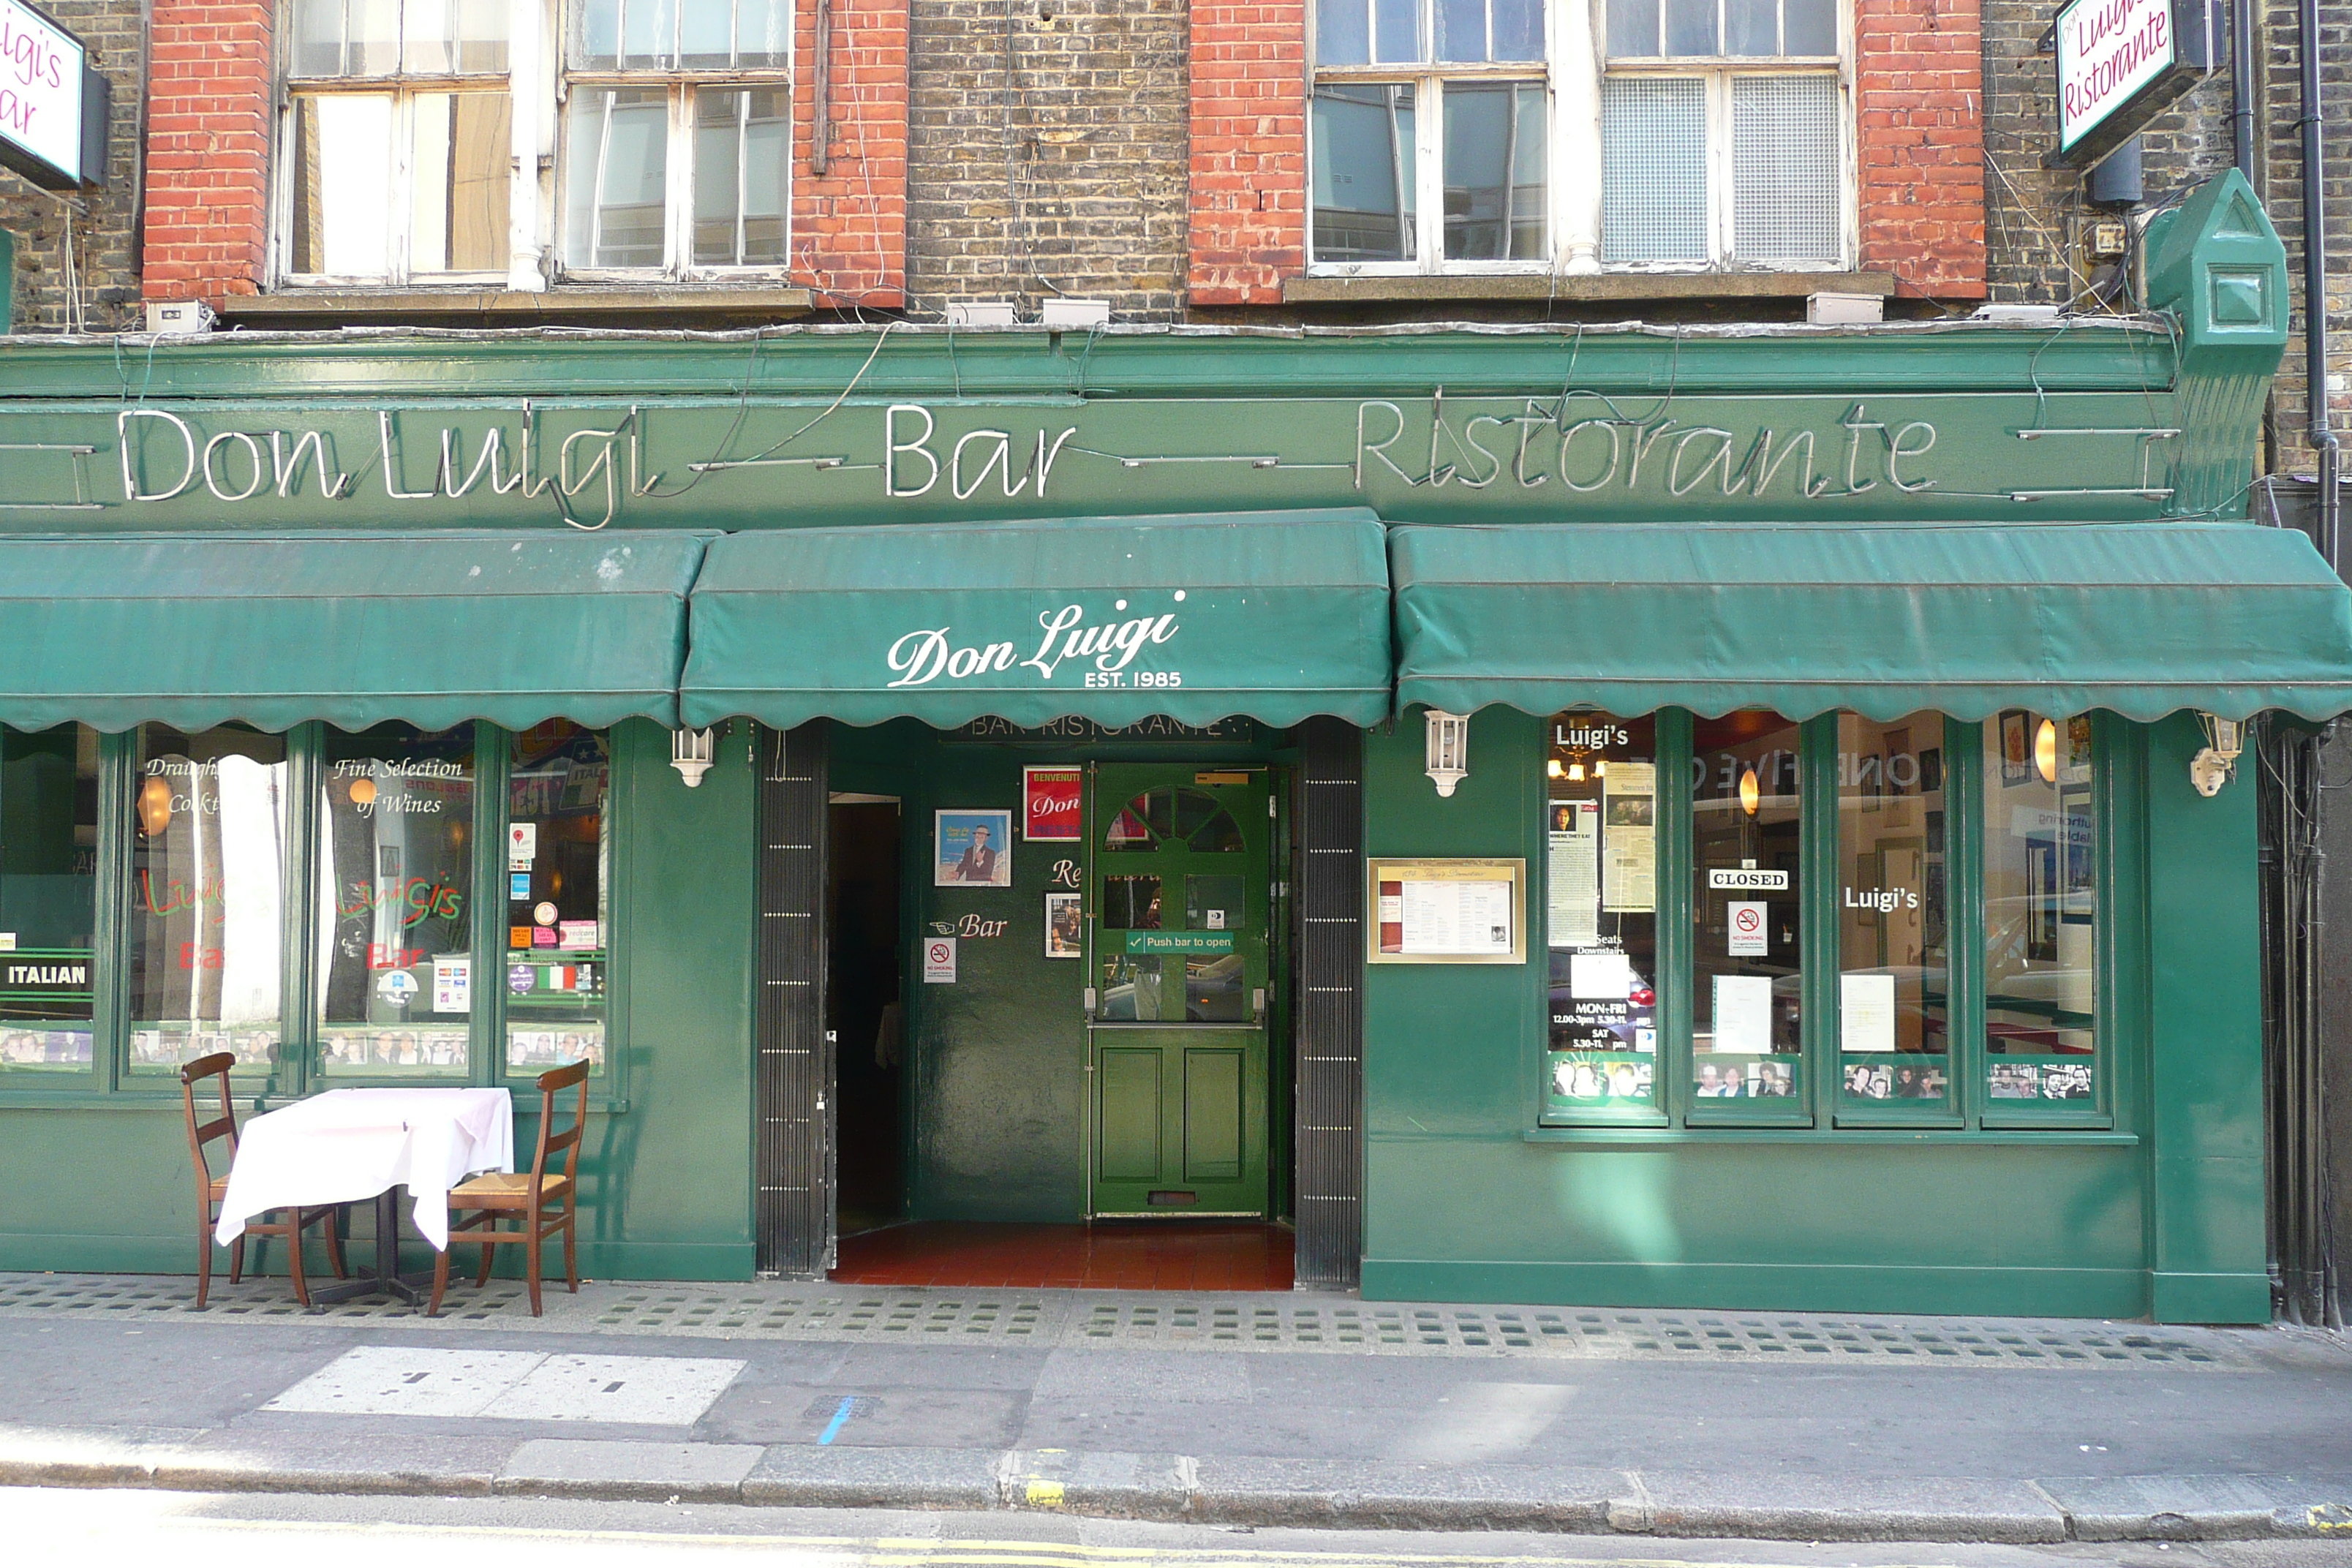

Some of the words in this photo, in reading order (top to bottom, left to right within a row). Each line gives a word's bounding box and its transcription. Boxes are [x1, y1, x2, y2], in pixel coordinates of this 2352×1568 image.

[2079, 0, 2143, 57] Luig
[0, 8, 61, 88] igi's
[2065, 11, 2168, 127] Ristorante
[0, 89, 37, 135] ar
[886, 404, 1077, 500] Bar
[1353, 385, 1938, 499] Ristorante
[118, 410, 348, 501] Don
[379, 398, 658, 531] Luigi
[887, 627, 1018, 687] Don
[1019, 589, 1186, 679] Luigi
[1085, 672, 1126, 687] EST.
[1133, 672, 1182, 687] 1985
[1556, 725, 1629, 750] Luigi's
[147, 756, 219, 780] Draugh
[333, 758, 375, 780] Fine
[380, 757, 463, 777] Selection
[1033, 773, 1080, 783] BENVENUTI
[356, 794, 381, 818] of
[382, 794, 442, 814] Wines
[1033, 794, 1080, 818] Don
[1033, 825, 1082, 836] RESTA
[1051, 859, 1082, 888] Re
[1713, 873, 1785, 886] CLOSED
[1845, 887, 1918, 913] Luigi's
[959, 913, 1008, 938] Bar
[1147, 937, 1172, 946] Push
[1175, 937, 1192, 946] bar
[1194, 938, 1204, 946] to
[1206, 939, 1231, 949] open
[1577, 946, 1624, 954] Downstairs
[1597, 934, 1623, 944] Seats
[367, 942, 425, 969] Bar
[9, 966, 86, 984] ITALIAN
[1553, 1014, 1595, 1025] 12.00-3pm
[1575, 1003, 1627, 1014] MON-FRI
[1592, 1029, 1609, 1038] SAT
[1613, 1040, 1627, 1050] pm
